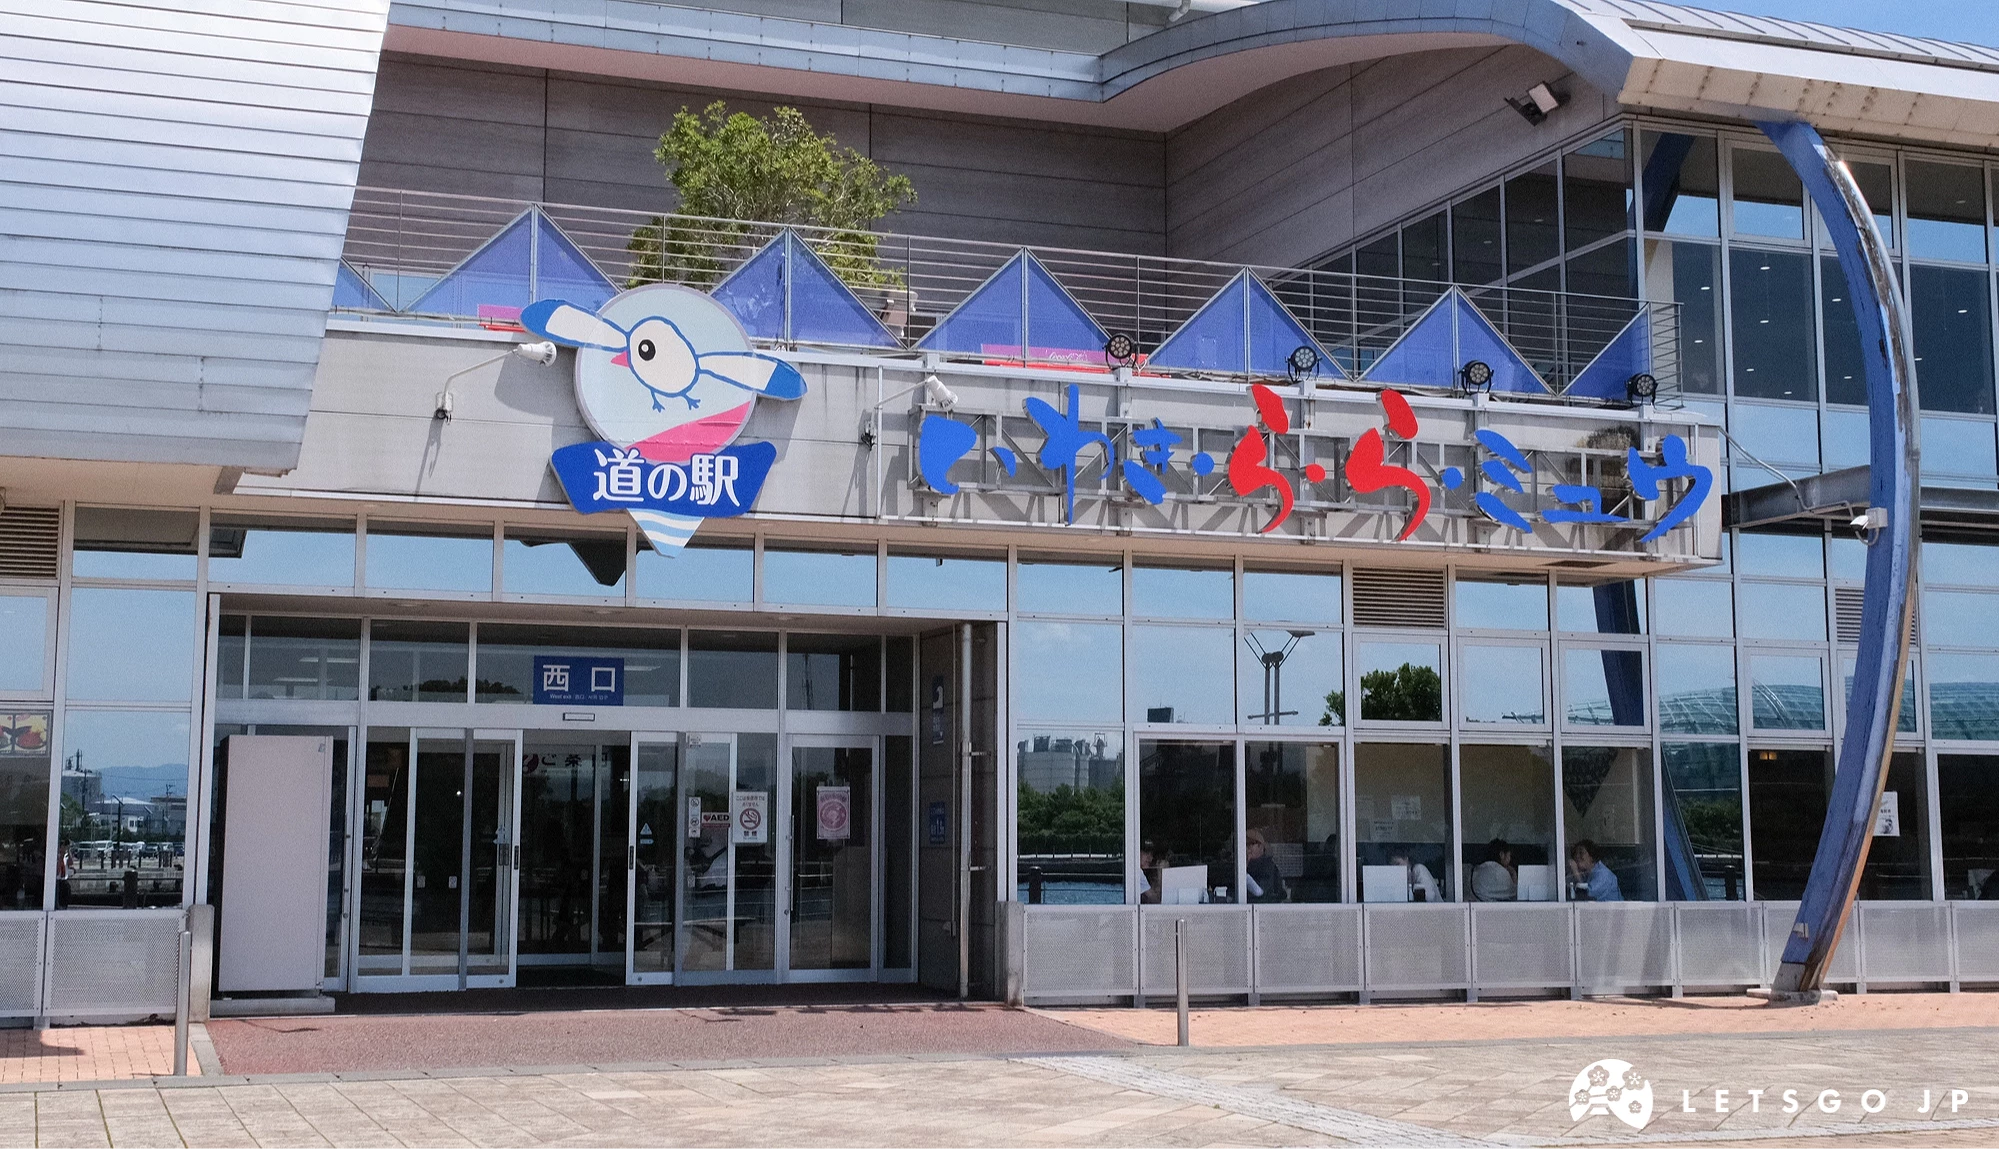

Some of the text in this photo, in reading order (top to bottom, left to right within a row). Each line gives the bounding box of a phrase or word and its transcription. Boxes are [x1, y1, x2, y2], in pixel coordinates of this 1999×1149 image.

[592, 447, 741, 508] 道の駅
[542, 664, 616, 692] 西口
[710, 814, 730, 822] AED
